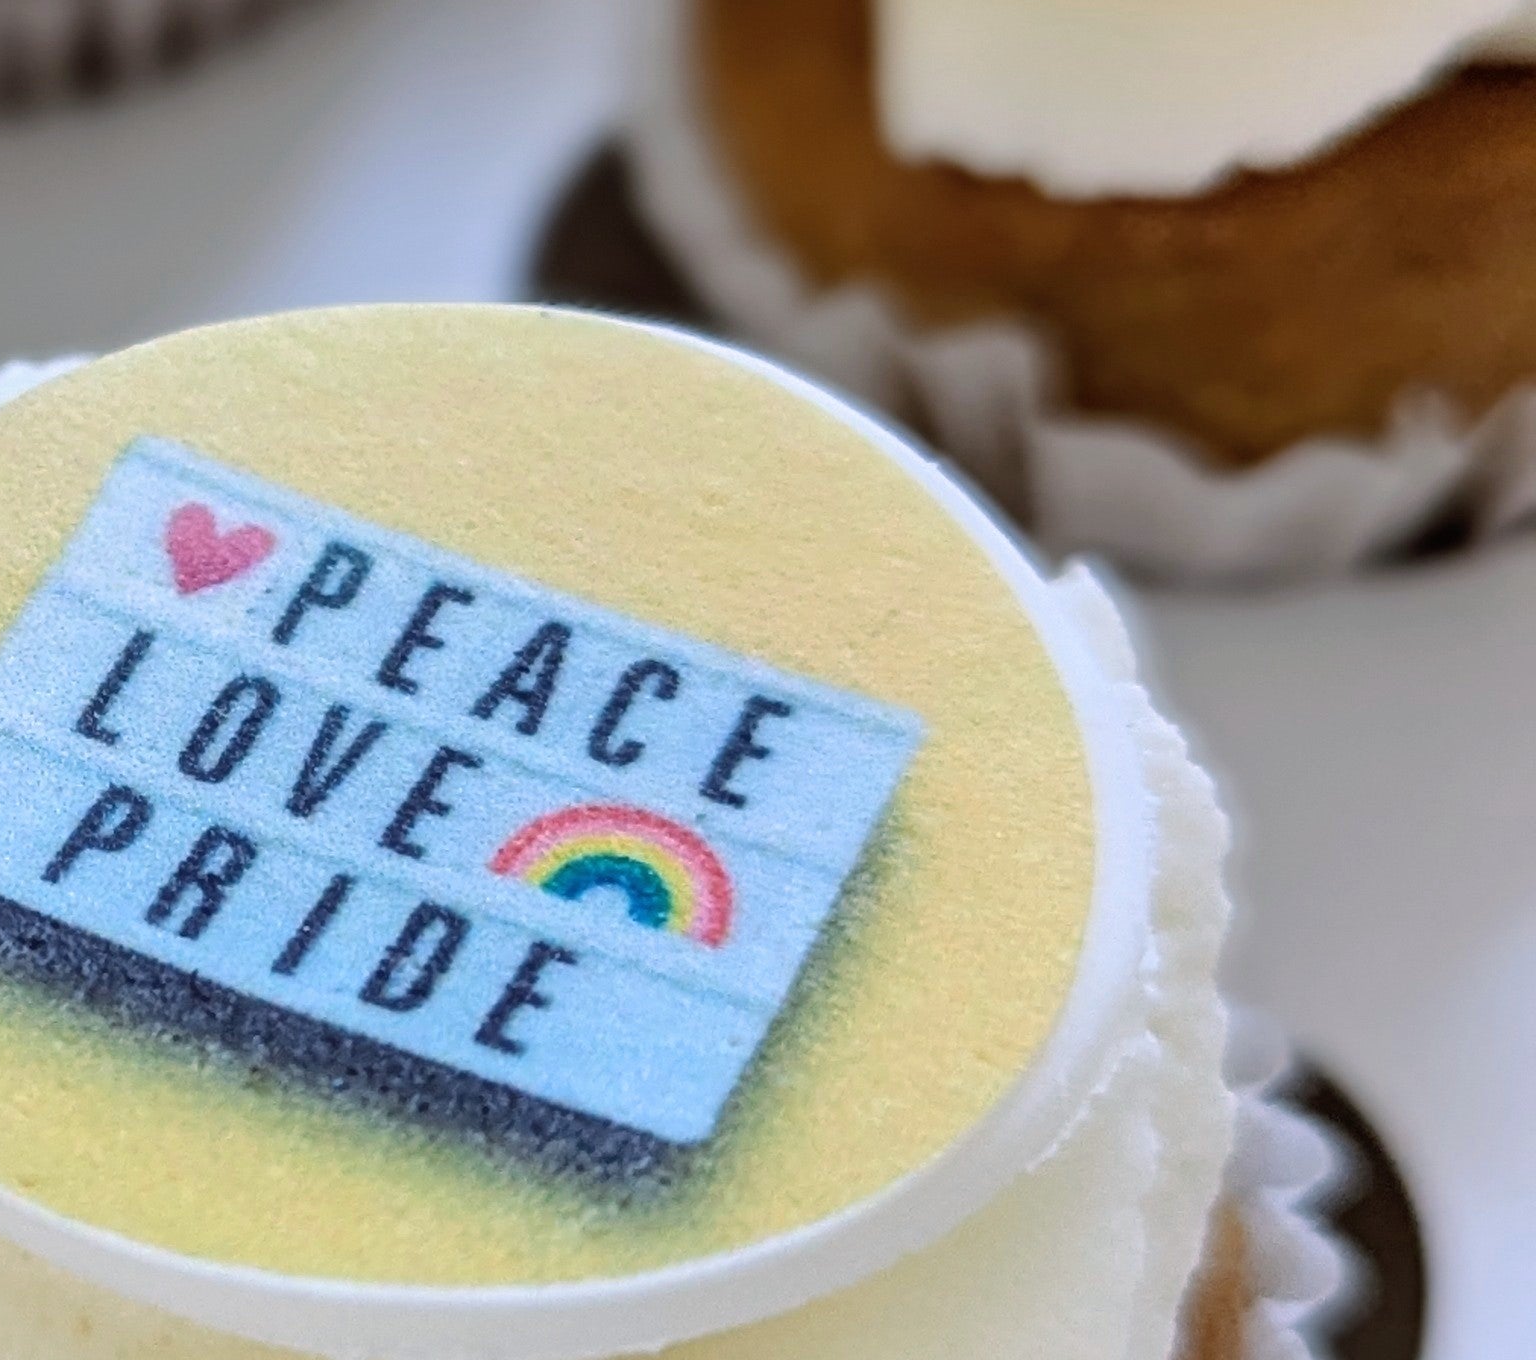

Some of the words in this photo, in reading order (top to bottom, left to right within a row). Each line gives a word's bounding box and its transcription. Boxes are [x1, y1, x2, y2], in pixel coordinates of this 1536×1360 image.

[72, 627, 484, 861] LOVE
[269, 539, 792, 811] PEACE
[38, 782, 580, 1057] PRIDE
